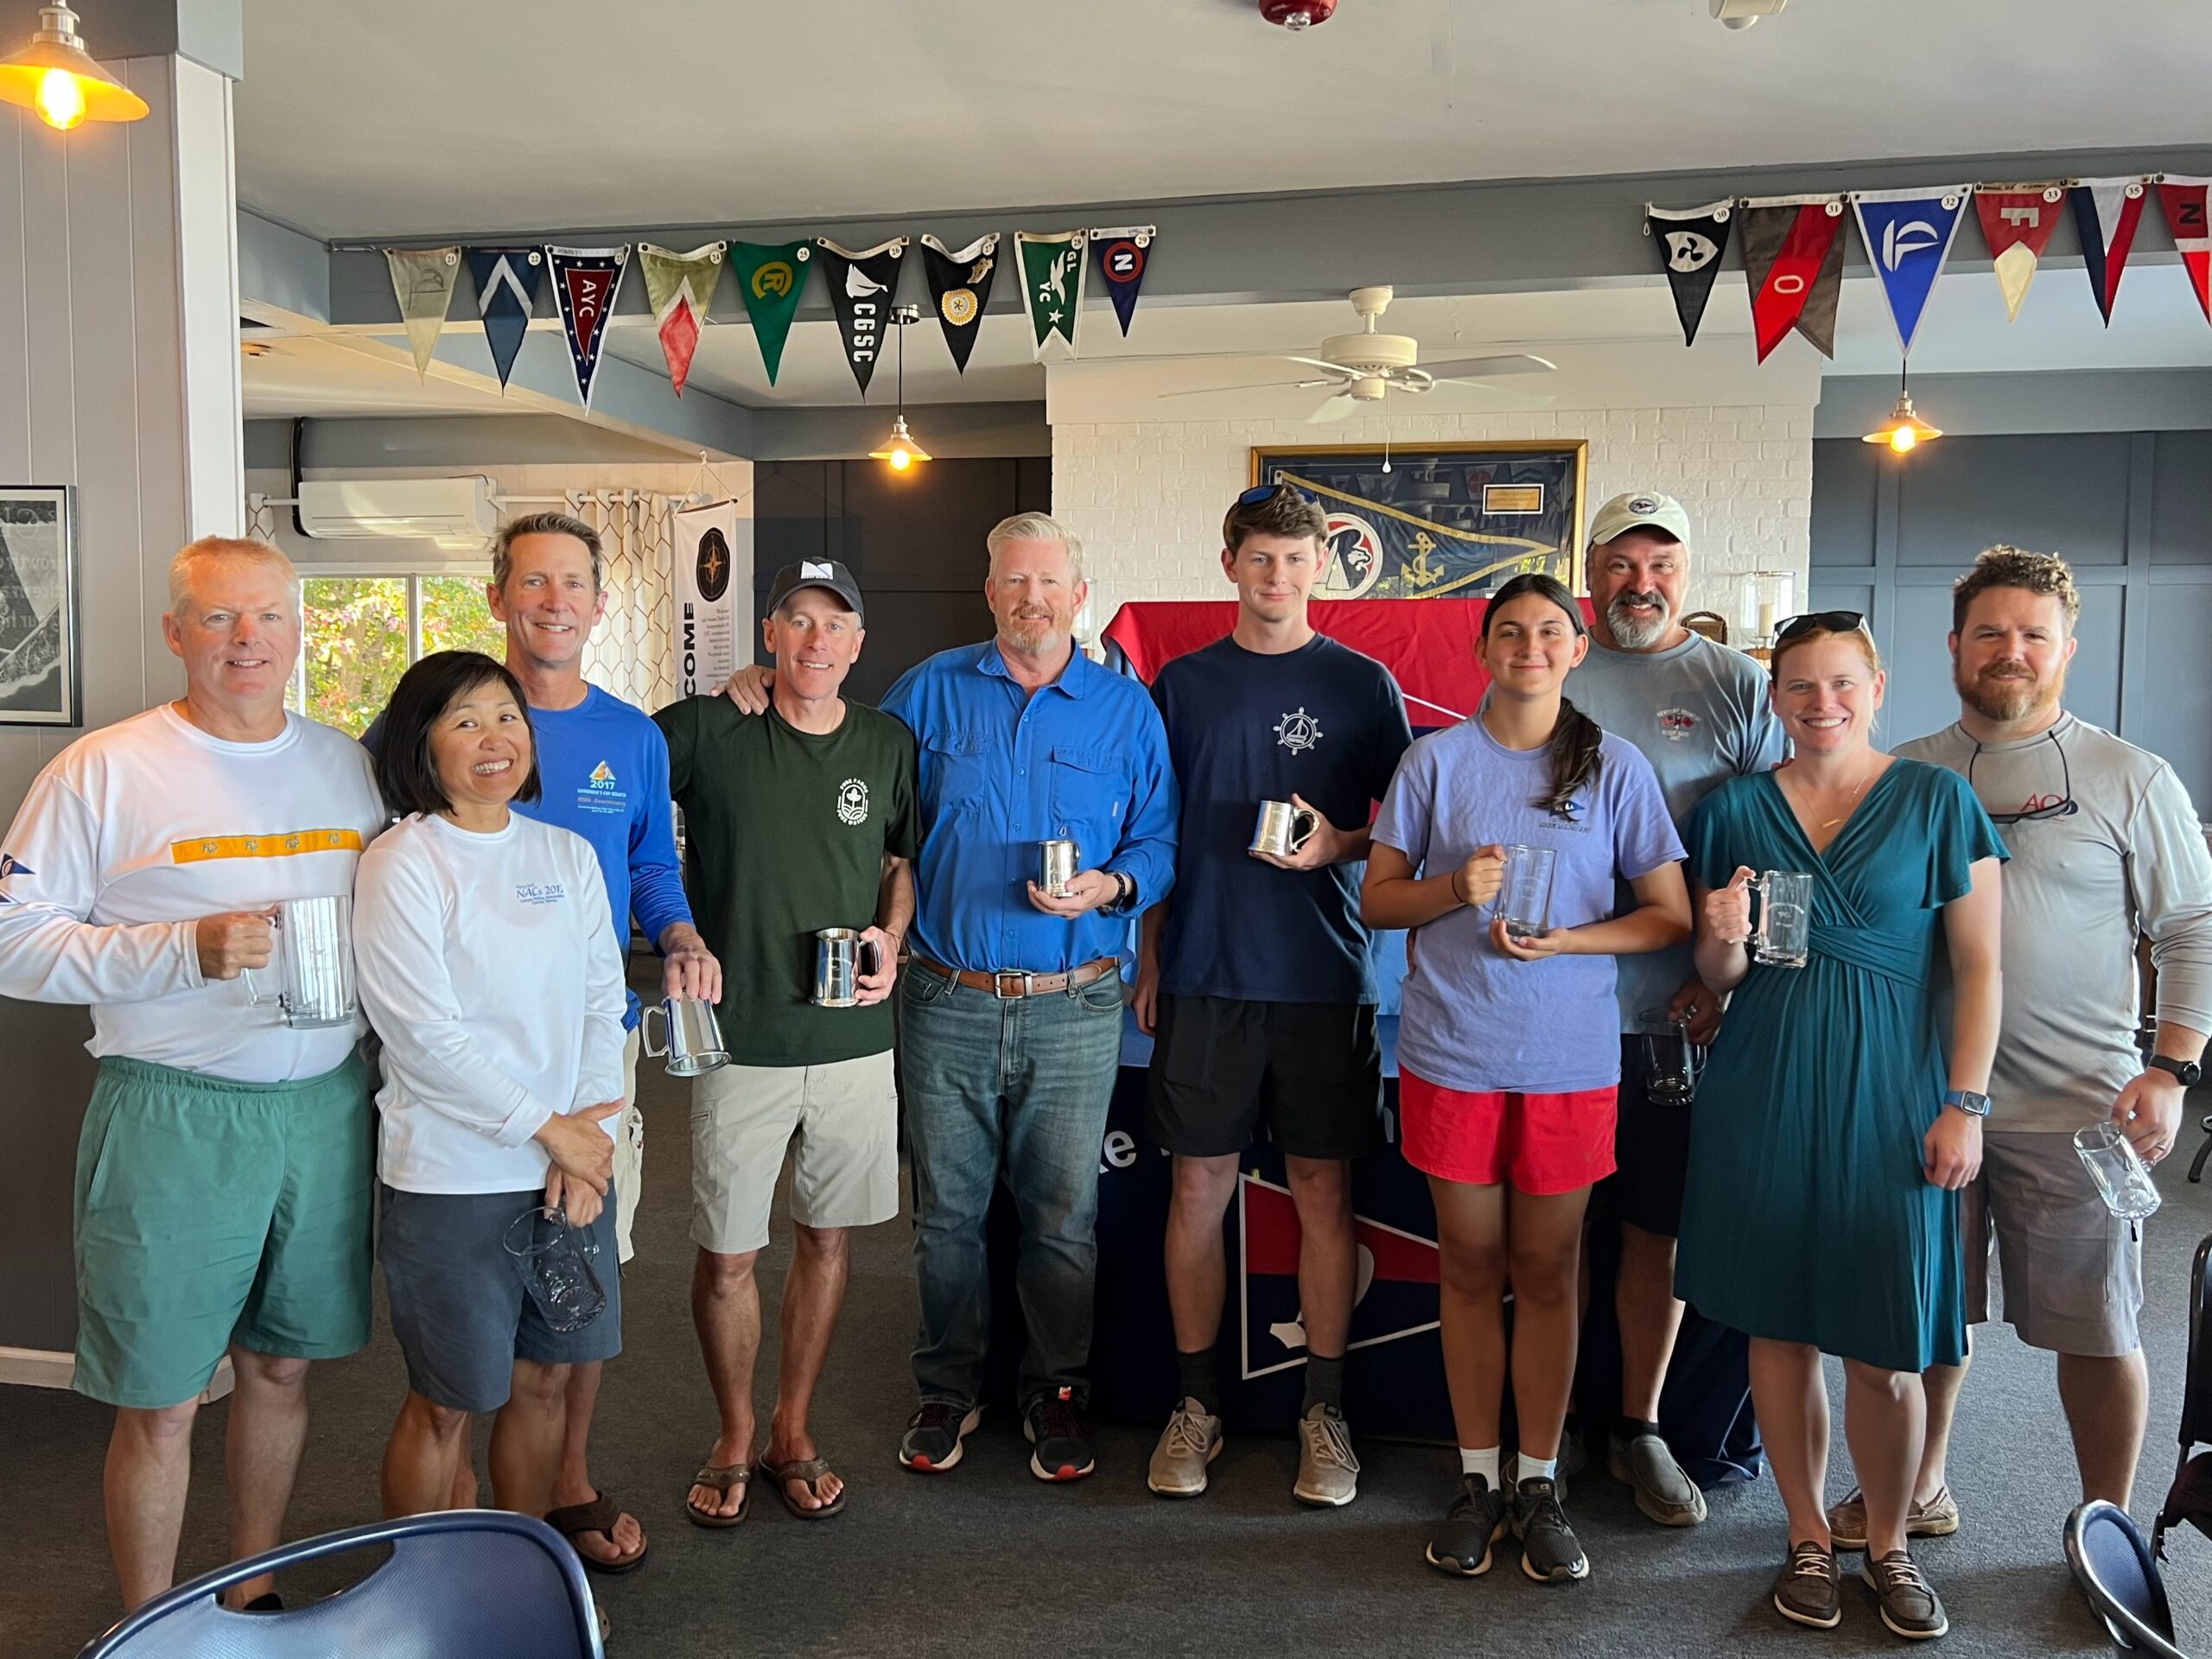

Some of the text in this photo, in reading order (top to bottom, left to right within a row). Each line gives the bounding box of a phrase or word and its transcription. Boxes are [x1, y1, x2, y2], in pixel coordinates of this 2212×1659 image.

[2045, 190, 2059, 200] 33
[2126, 186, 2140, 195] 35
[1943, 197, 1955, 207] 32
[1827, 204, 1840, 213] 31
[2178, 202, 2202, 225] N
[1715, 210, 1727, 220] 30
[2000, 207, 2039, 228] F
[1072, 238, 1082, 247] 28
[1137, 236, 1147, 245] 29
[891, 247, 900, 256] 26
[985, 243, 993, 253] 27
[616, 254, 623, 263] 23
[799, 250, 808, 258] 25
[447, 255, 454, 264] 21
[1066, 251, 1077, 273] GL
[1114, 253, 1134, 271] N
[1039, 281, 1052, 302] YC
[578, 279, 597, 318] AYC
[853, 302, 876, 363] CGSC
[683, 602, 696, 698] COME
[589, 780, 615, 790] 2017
[517, 886, 543, 899] NACs
